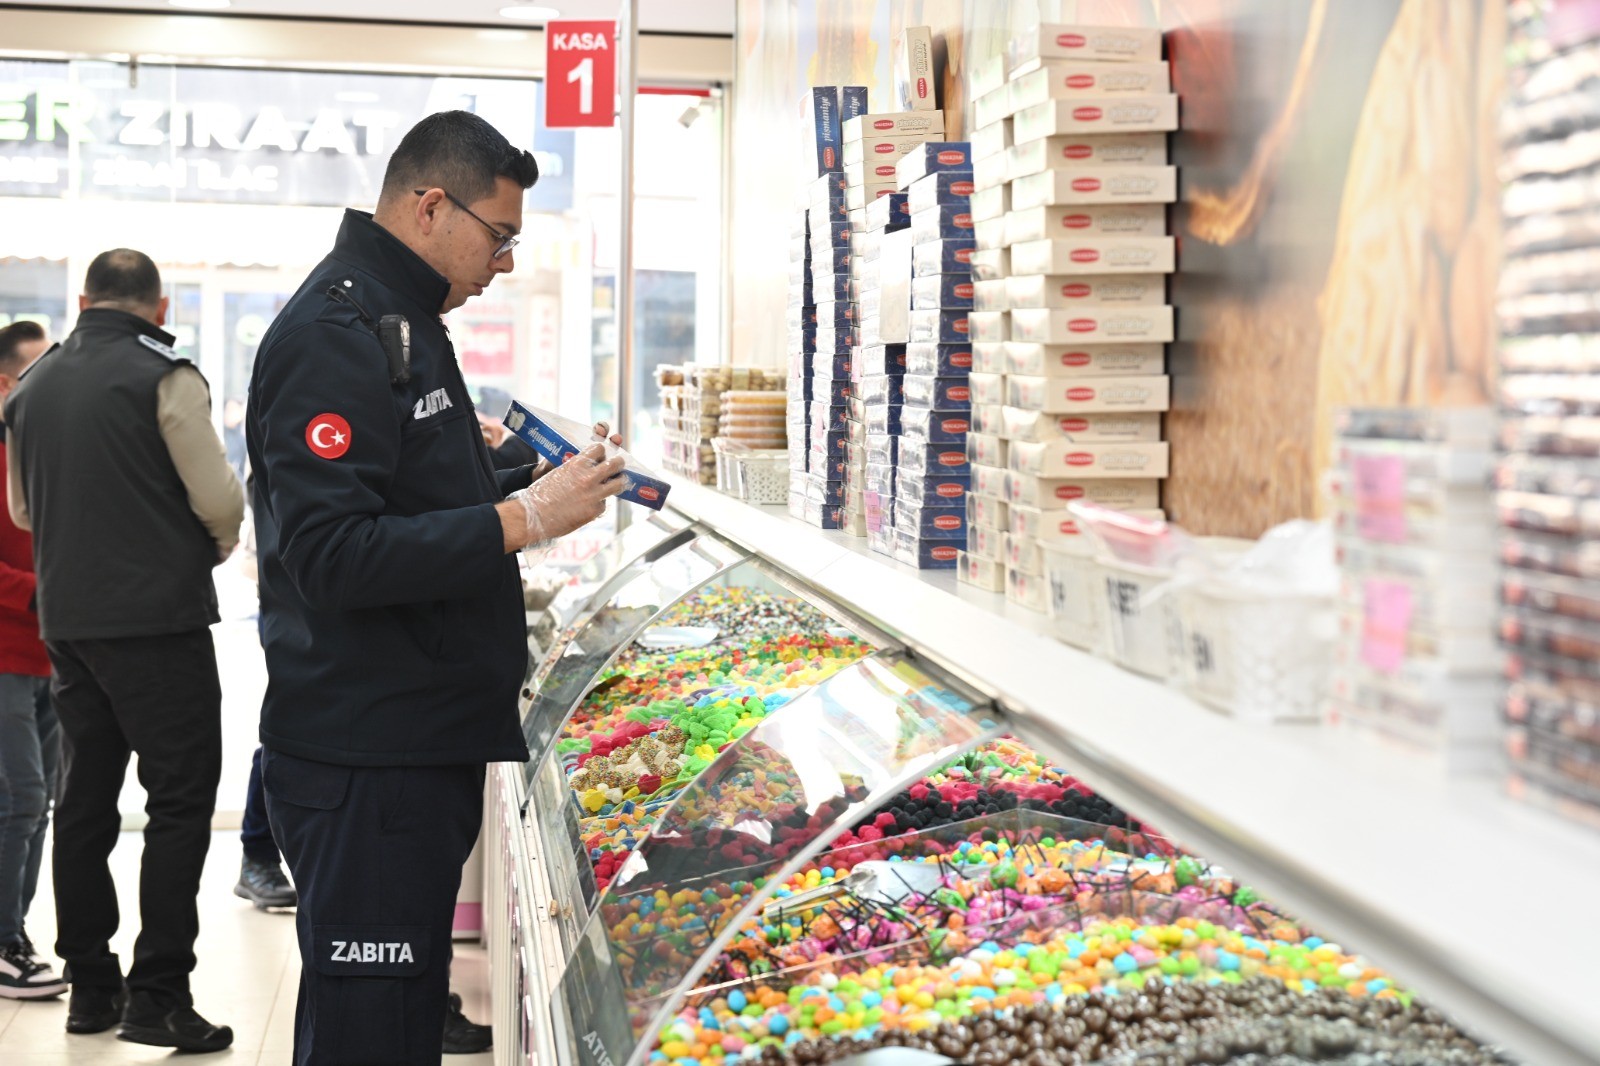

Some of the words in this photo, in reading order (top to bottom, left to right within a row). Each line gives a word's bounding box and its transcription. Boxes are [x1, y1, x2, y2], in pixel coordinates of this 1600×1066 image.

[553, 32, 608, 51] KASA
[567, 57, 593, 115] 1
[820, 96, 834, 142] pişmaniye
[527, 426, 563, 457] pişmaniye
[331, 941, 415, 963] ZABITA
